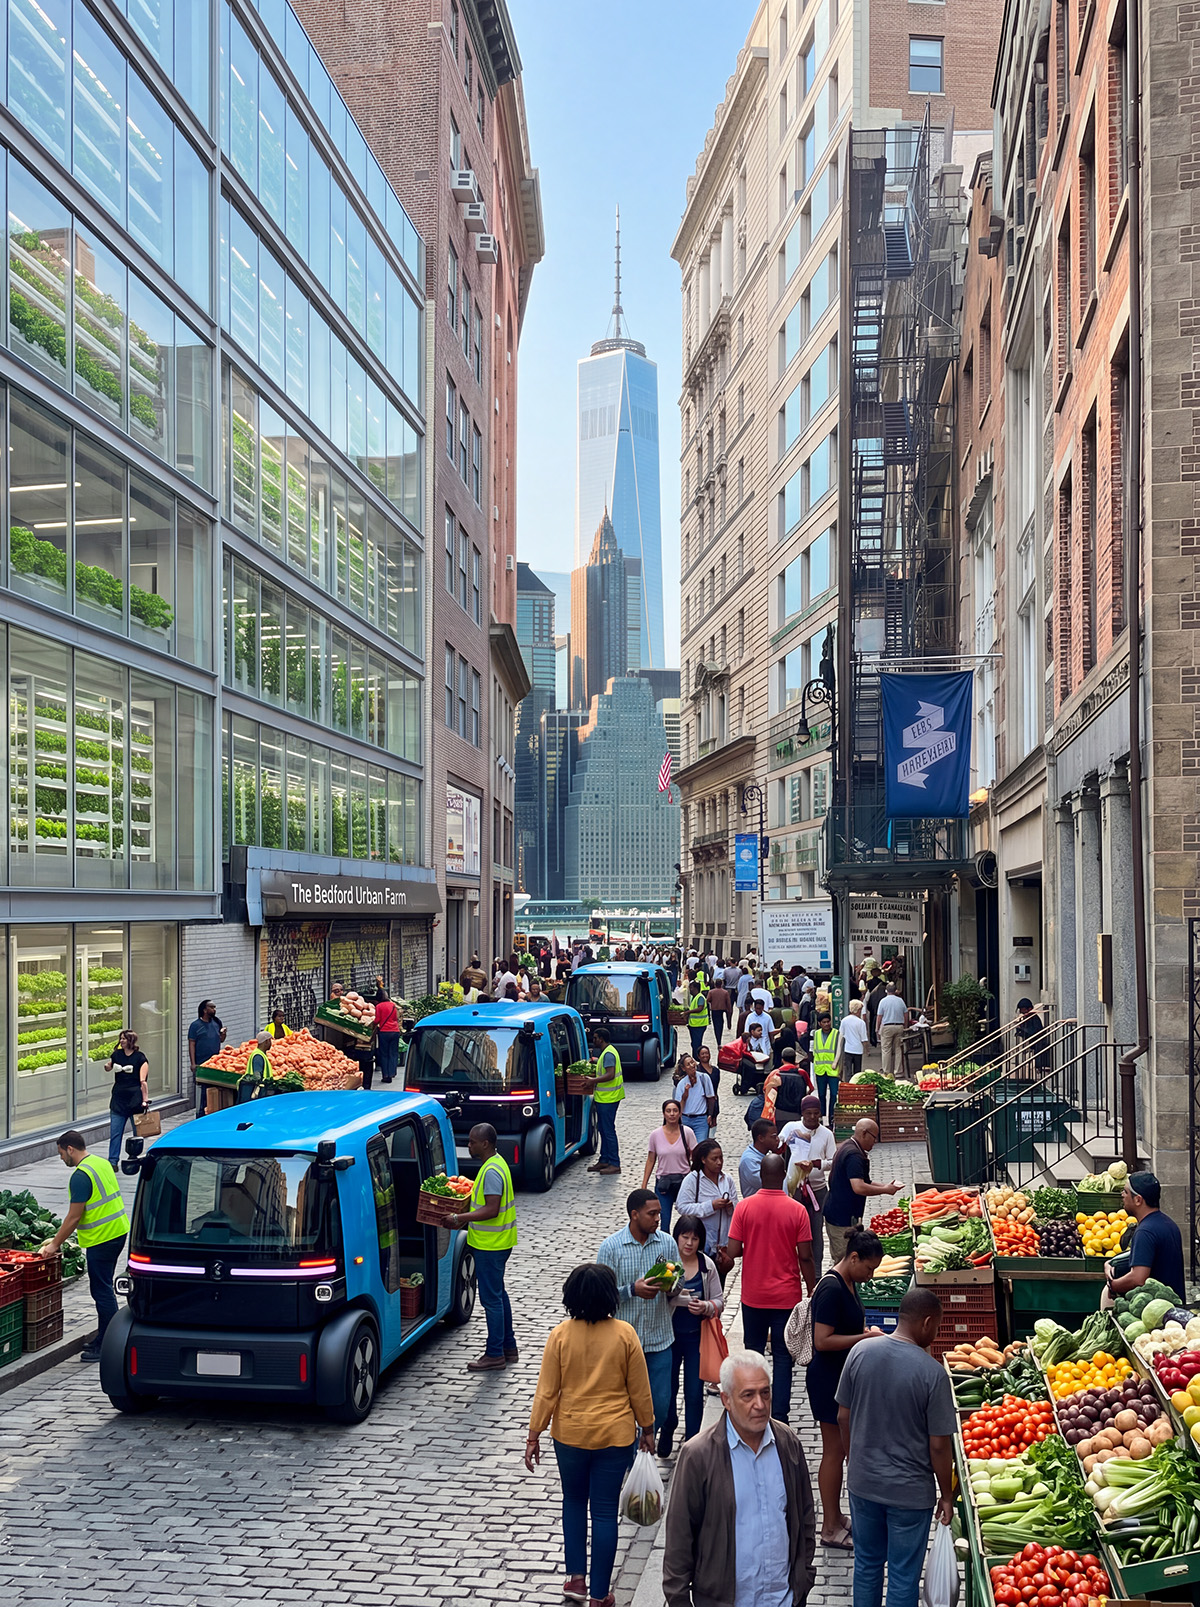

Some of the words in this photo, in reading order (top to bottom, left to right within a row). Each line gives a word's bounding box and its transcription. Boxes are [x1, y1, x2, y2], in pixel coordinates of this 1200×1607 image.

[291, 883, 312, 904] The
[314, 884, 354, 905] Bedford
[355, 886, 383, 905] Urban
[385, 887, 407, 905] Farm
